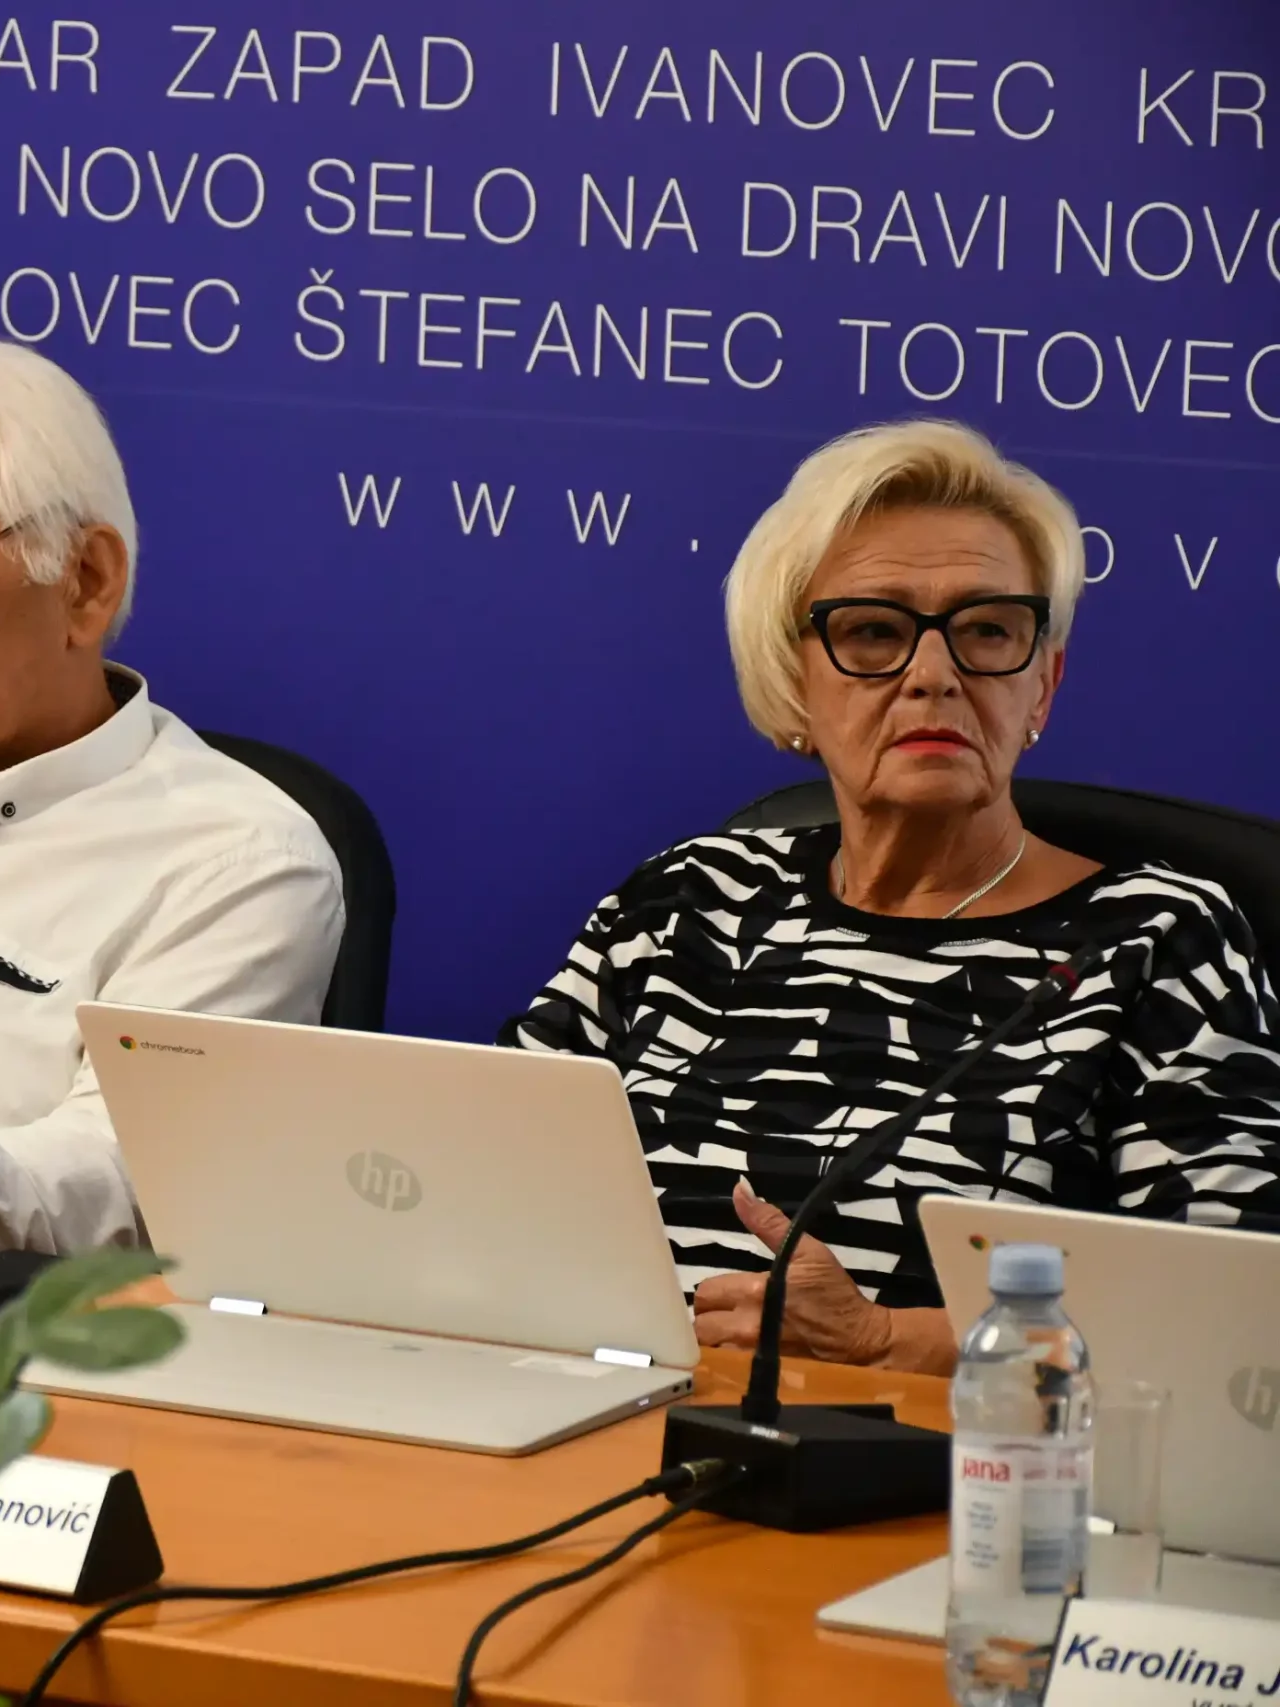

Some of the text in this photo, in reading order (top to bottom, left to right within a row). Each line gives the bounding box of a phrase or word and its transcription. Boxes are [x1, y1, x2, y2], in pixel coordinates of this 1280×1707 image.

[165, 24, 474, 111] ZAPAD
[549, 41, 1055, 141] IVANOVEC
[1137, 67, 1267, 150] KR
[17, 143, 265, 230] NOVO
[304, 157, 537, 245] SELO
[579, 172, 699, 254] NA
[740, 181, 1007, 272] DRAVI
[1054, 198, 1280, 285] NOV
[293, 267, 784, 390] ŠTEFANEC
[140, 1041, 206, 1056] chromebook
[358, 1150, 413, 1211] hp
[1062, 1633, 1245, 1692] Karolina
